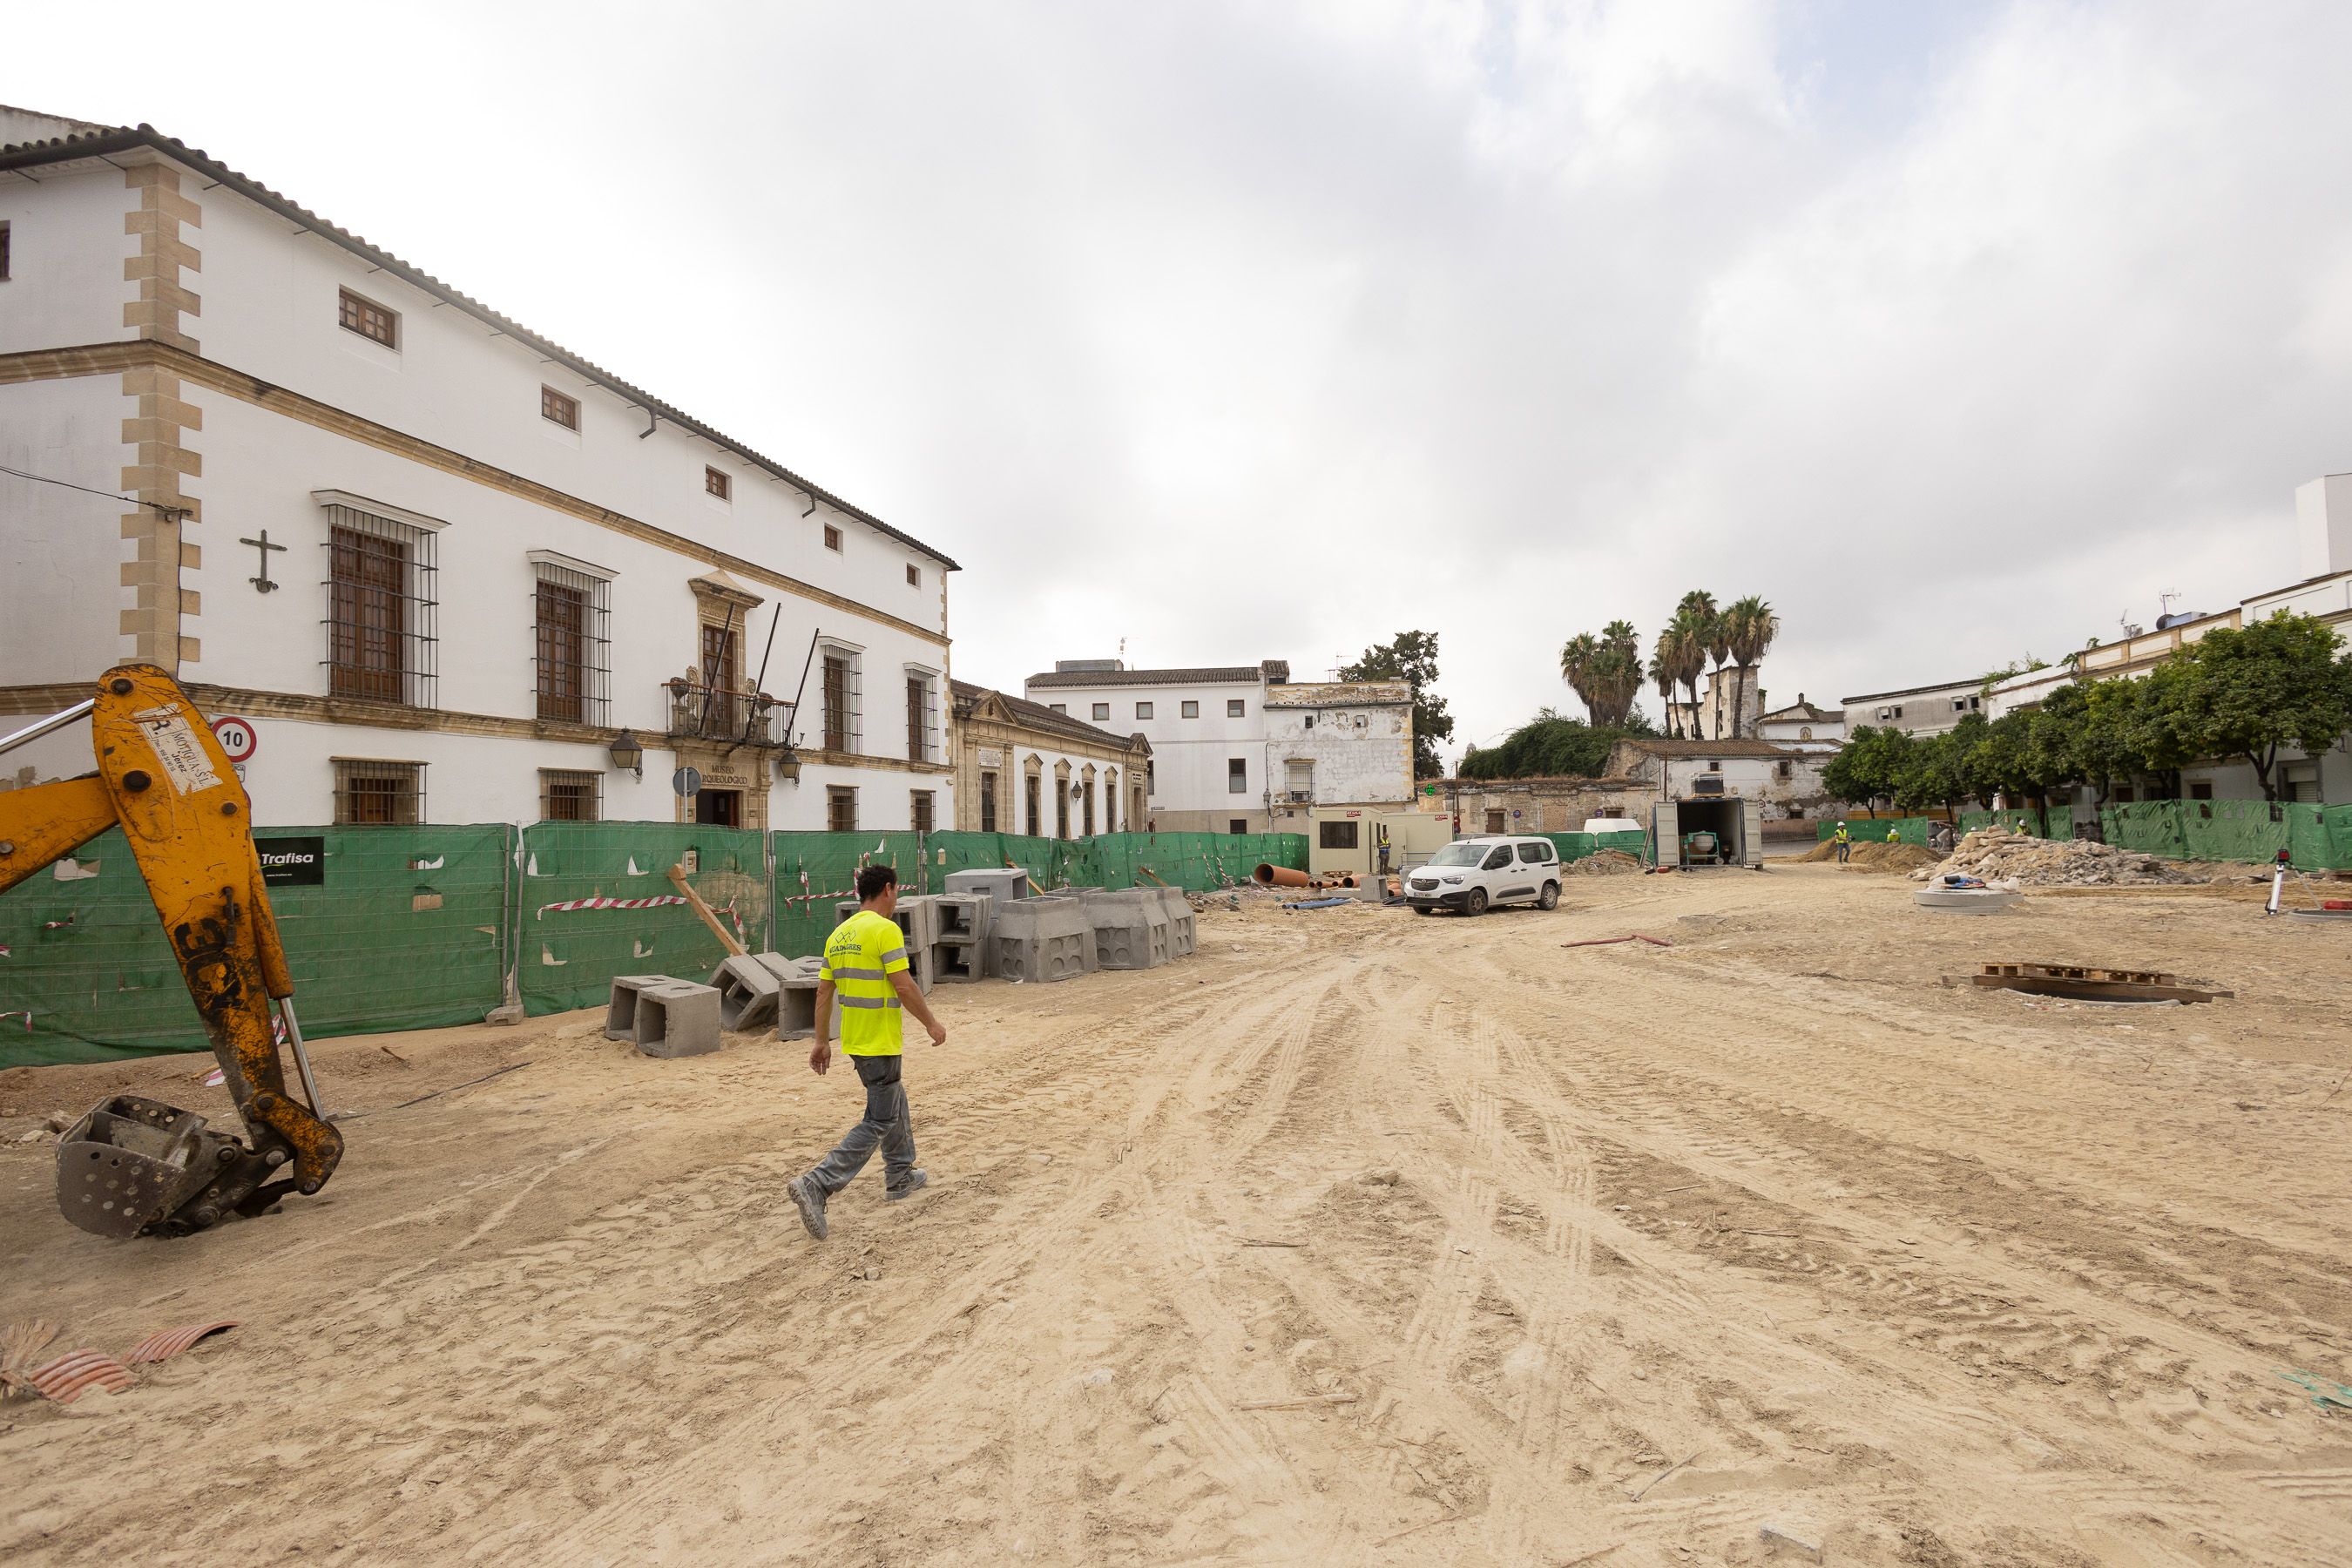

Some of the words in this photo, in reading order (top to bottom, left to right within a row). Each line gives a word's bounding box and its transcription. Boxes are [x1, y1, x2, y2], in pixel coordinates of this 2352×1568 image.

[223, 730, 243, 747] 10
[171, 753, 187, 774] Jerez
[712, 765, 734, 774] MUSEO
[702, 774, 747, 784] RQUEOLOGICO
[261, 853, 314, 864] Trafisa
